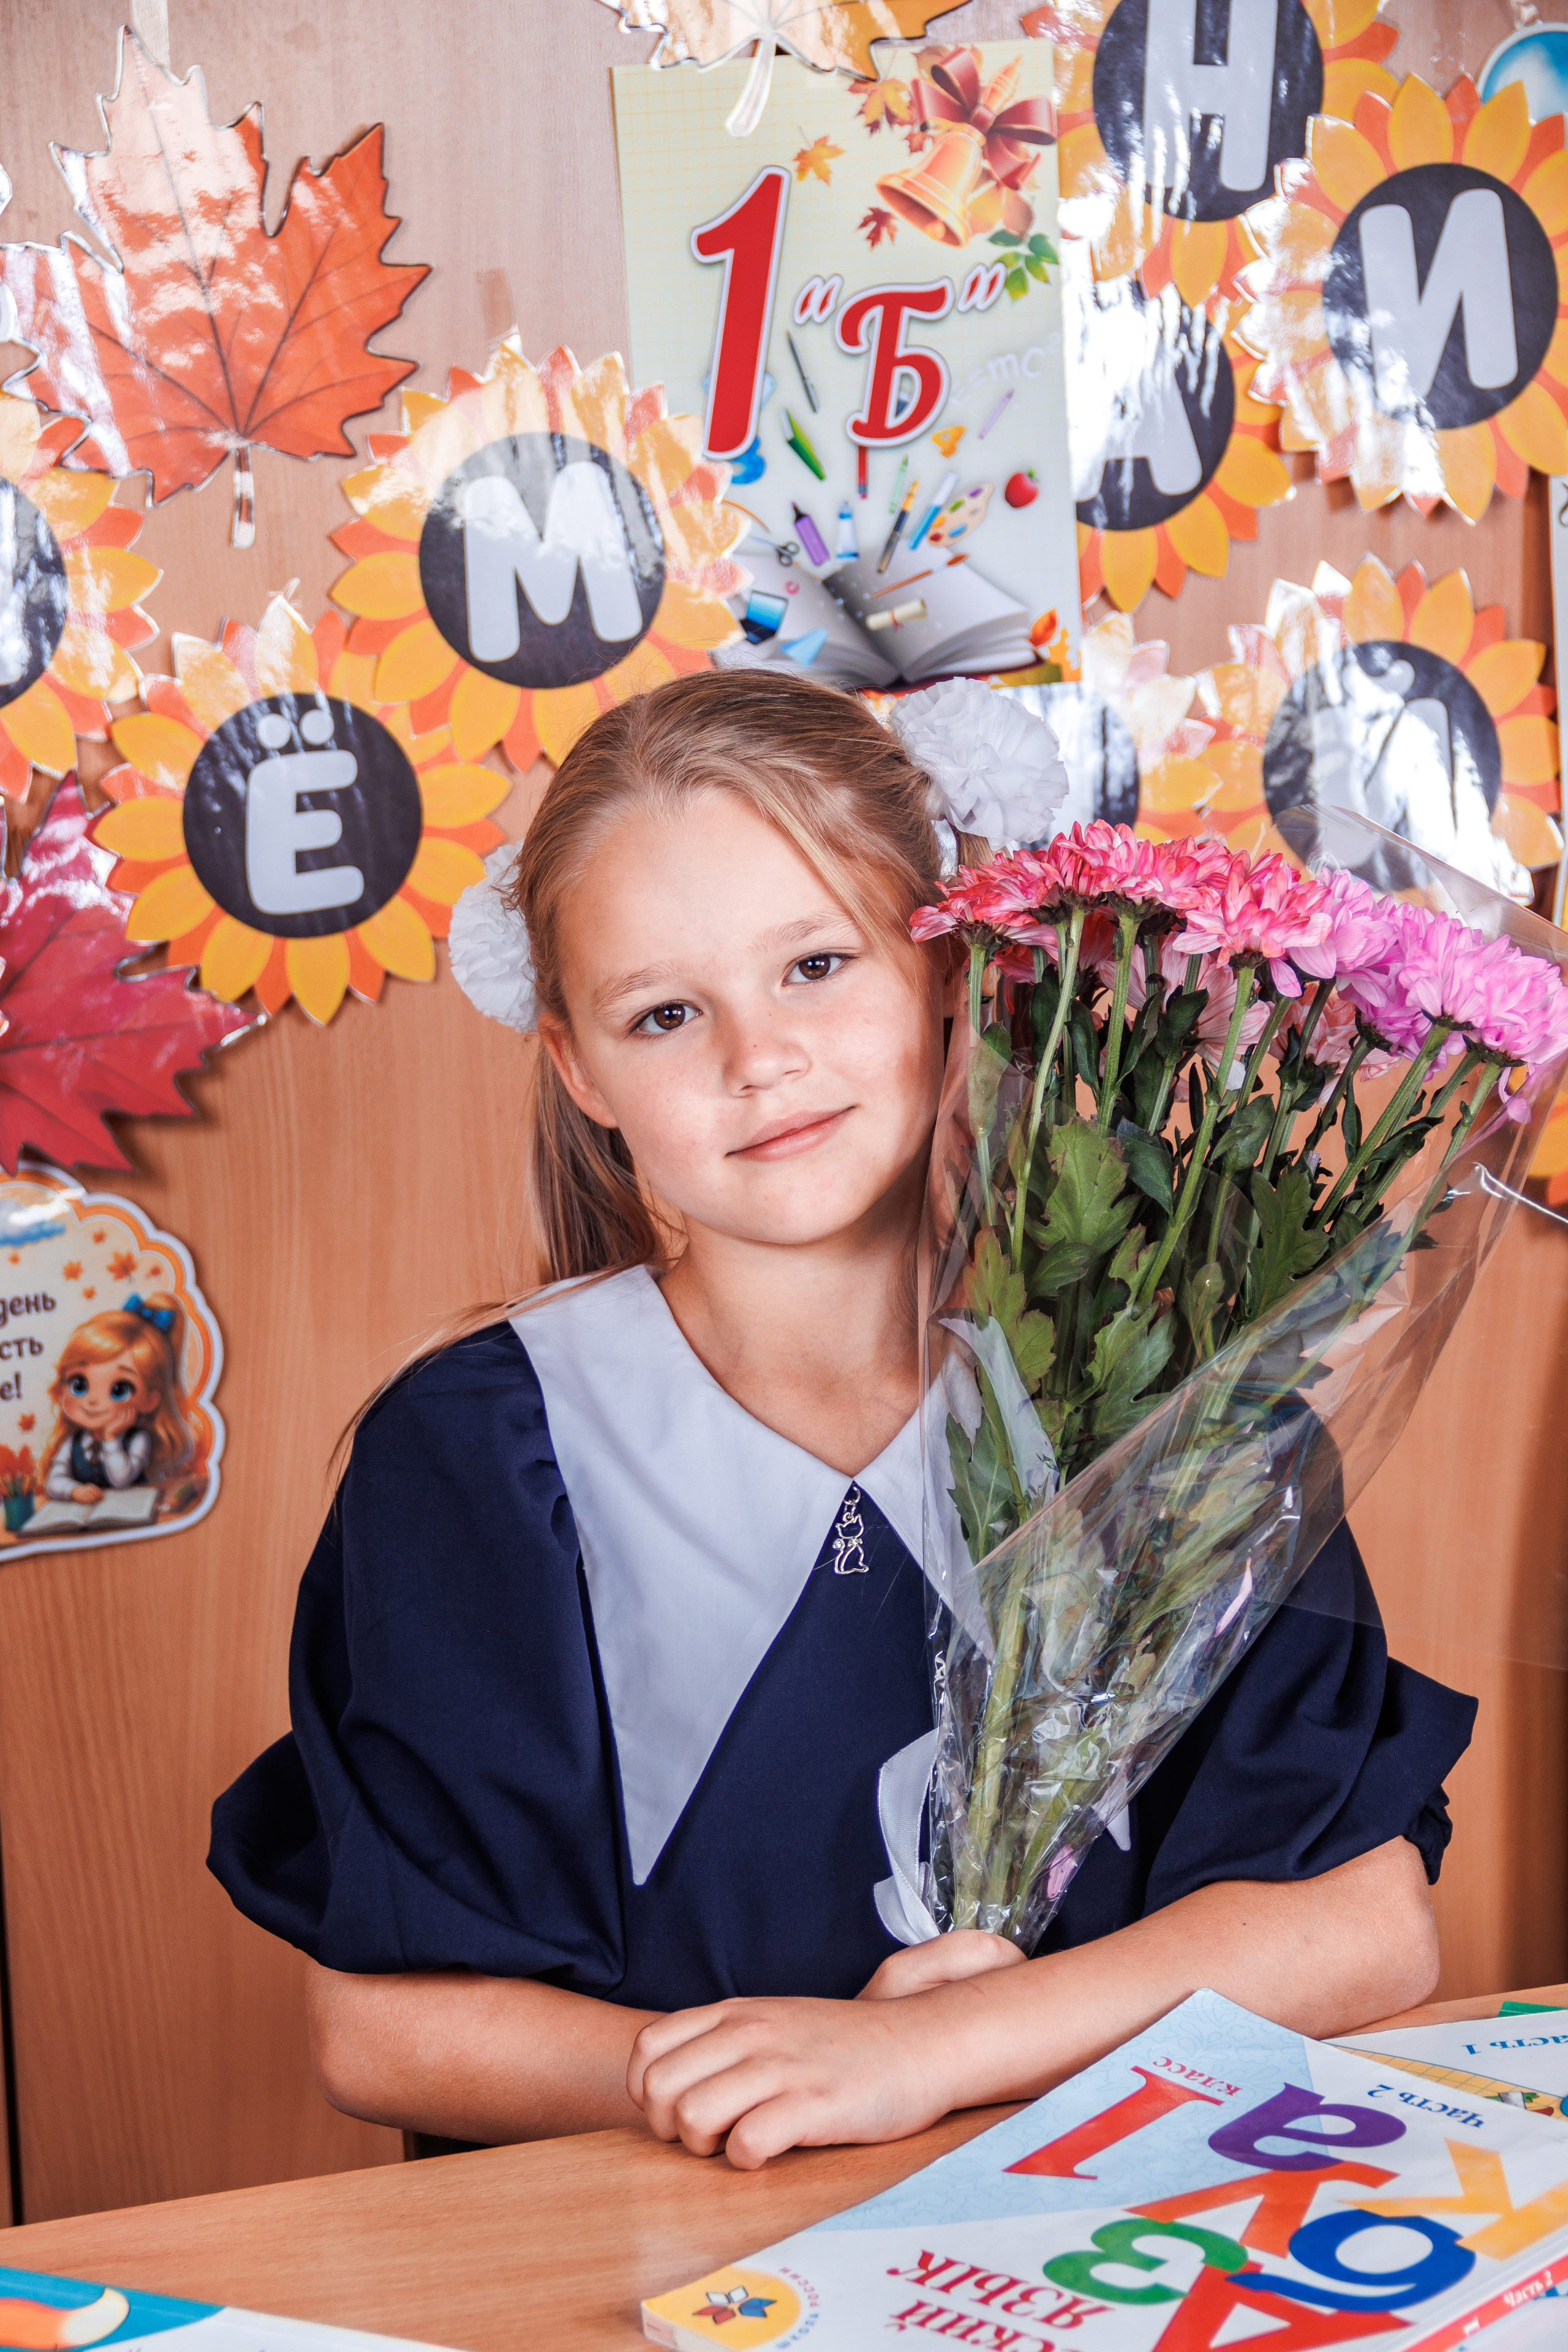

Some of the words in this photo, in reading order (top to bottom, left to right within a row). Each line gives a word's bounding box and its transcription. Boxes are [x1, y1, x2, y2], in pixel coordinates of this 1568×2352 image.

[1144, 0, 1278, 191] Н
[692, 167, 790, 458] 1
[1359, 187, 1519, 405] И
[464, 461, 643, 662] М
[247, 709, 364, 915] Ё
[1366, 2084, 1395, 2098] 2
[1398, 2091, 1485, 2128] Часть
[1461, 2043, 1482, 2055] 1
[1001, 2065, 1226, 2180] 1
[1152, 2056, 1244, 2097] класс
[885, 2299, 1082, 2352] СКИЙ
[886, 2248, 1116, 2330] ЯЗЫК
